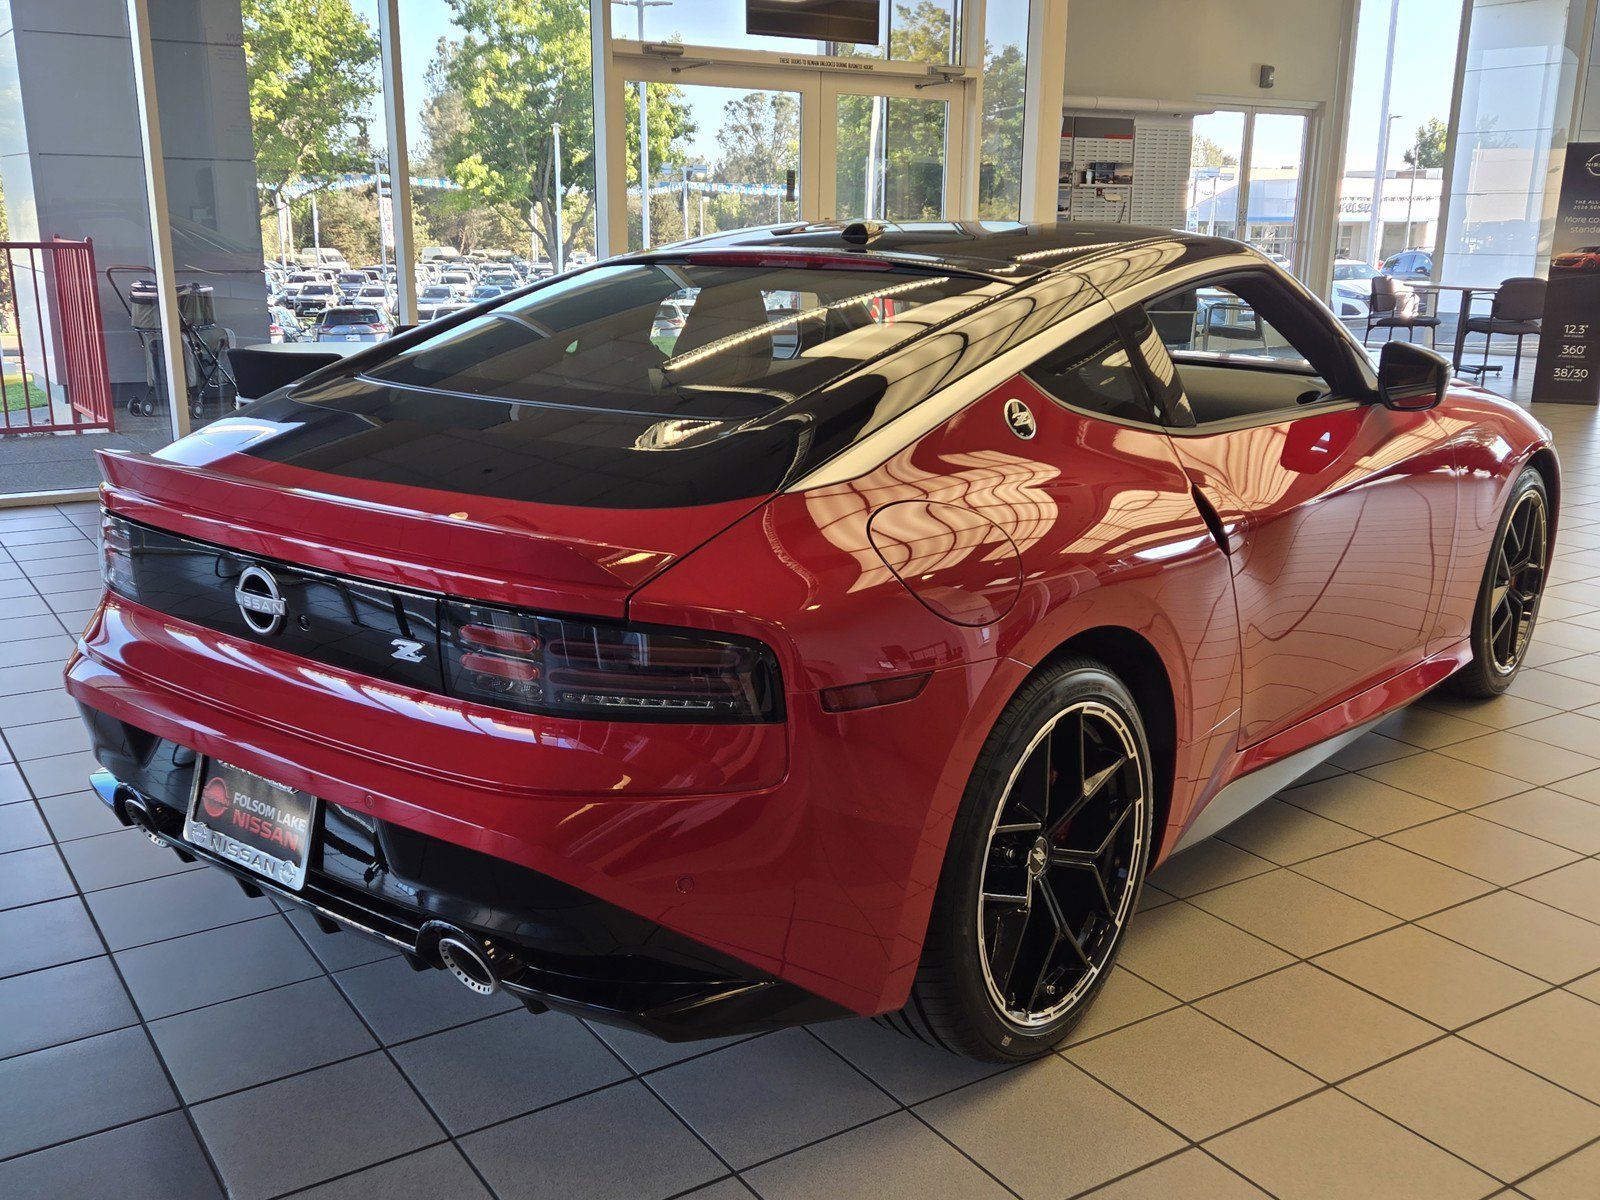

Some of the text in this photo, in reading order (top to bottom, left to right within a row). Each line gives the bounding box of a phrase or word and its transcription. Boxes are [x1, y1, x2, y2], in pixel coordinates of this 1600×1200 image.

[1564, 216, 1587, 224] More
[1554, 368, 1588, 378] 38/30
[235, 591, 284, 615] NISSAN
[391, 639, 427, 663] Z
[233, 792, 276, 819] FOLSOM
[277, 810, 307, 832] LAKE
[232, 809, 299, 851] NISSAN
[210, 834, 276, 876] NISSAN
